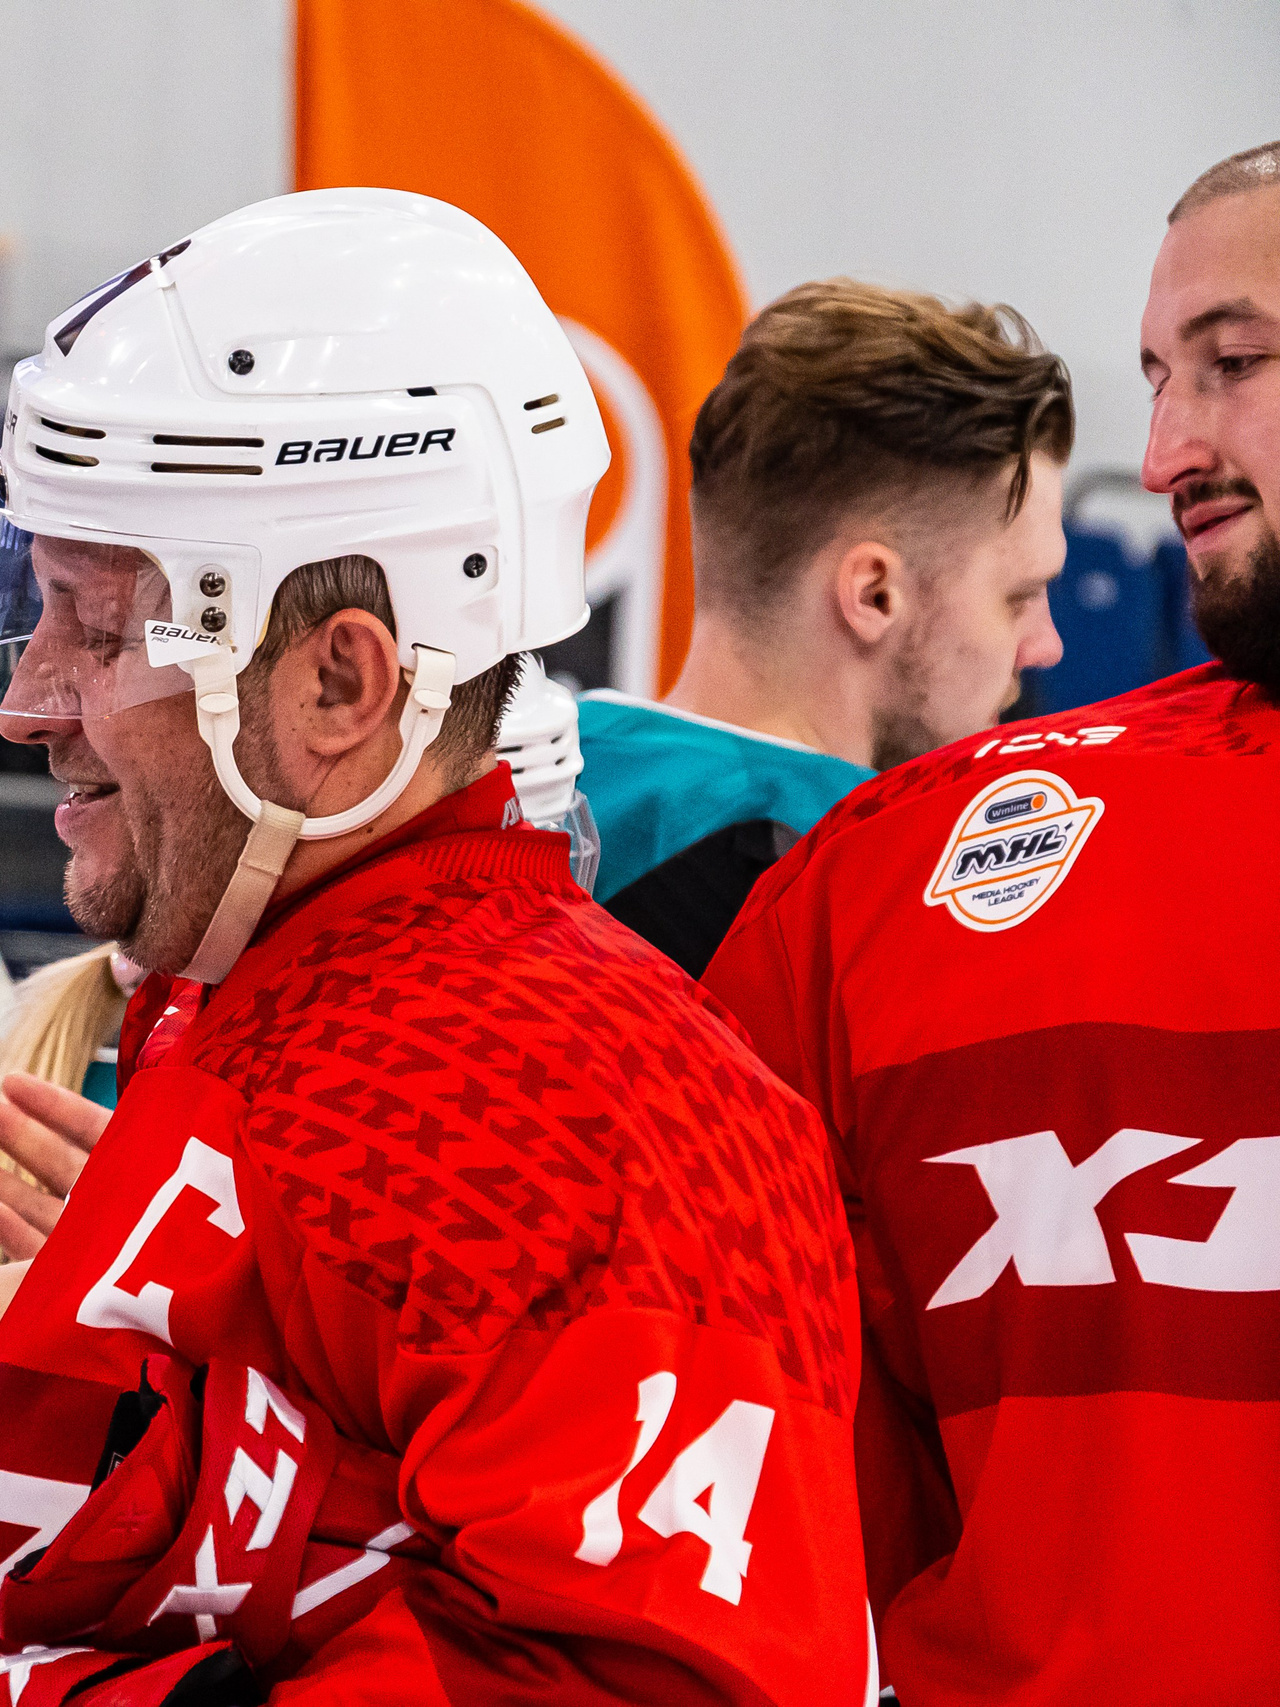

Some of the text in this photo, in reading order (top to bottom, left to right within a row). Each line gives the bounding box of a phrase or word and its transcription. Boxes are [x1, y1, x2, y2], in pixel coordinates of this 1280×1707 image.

[274, 427, 456, 466] BAUER
[955, 828, 1063, 877] MHL
[971, 876, 1041, 902] MEDIA HOCKEY
[987, 889, 1025, 907] LEAGUE
[921, 1129, 1280, 1311] X1
[573, 1371, 776, 1606] 14
